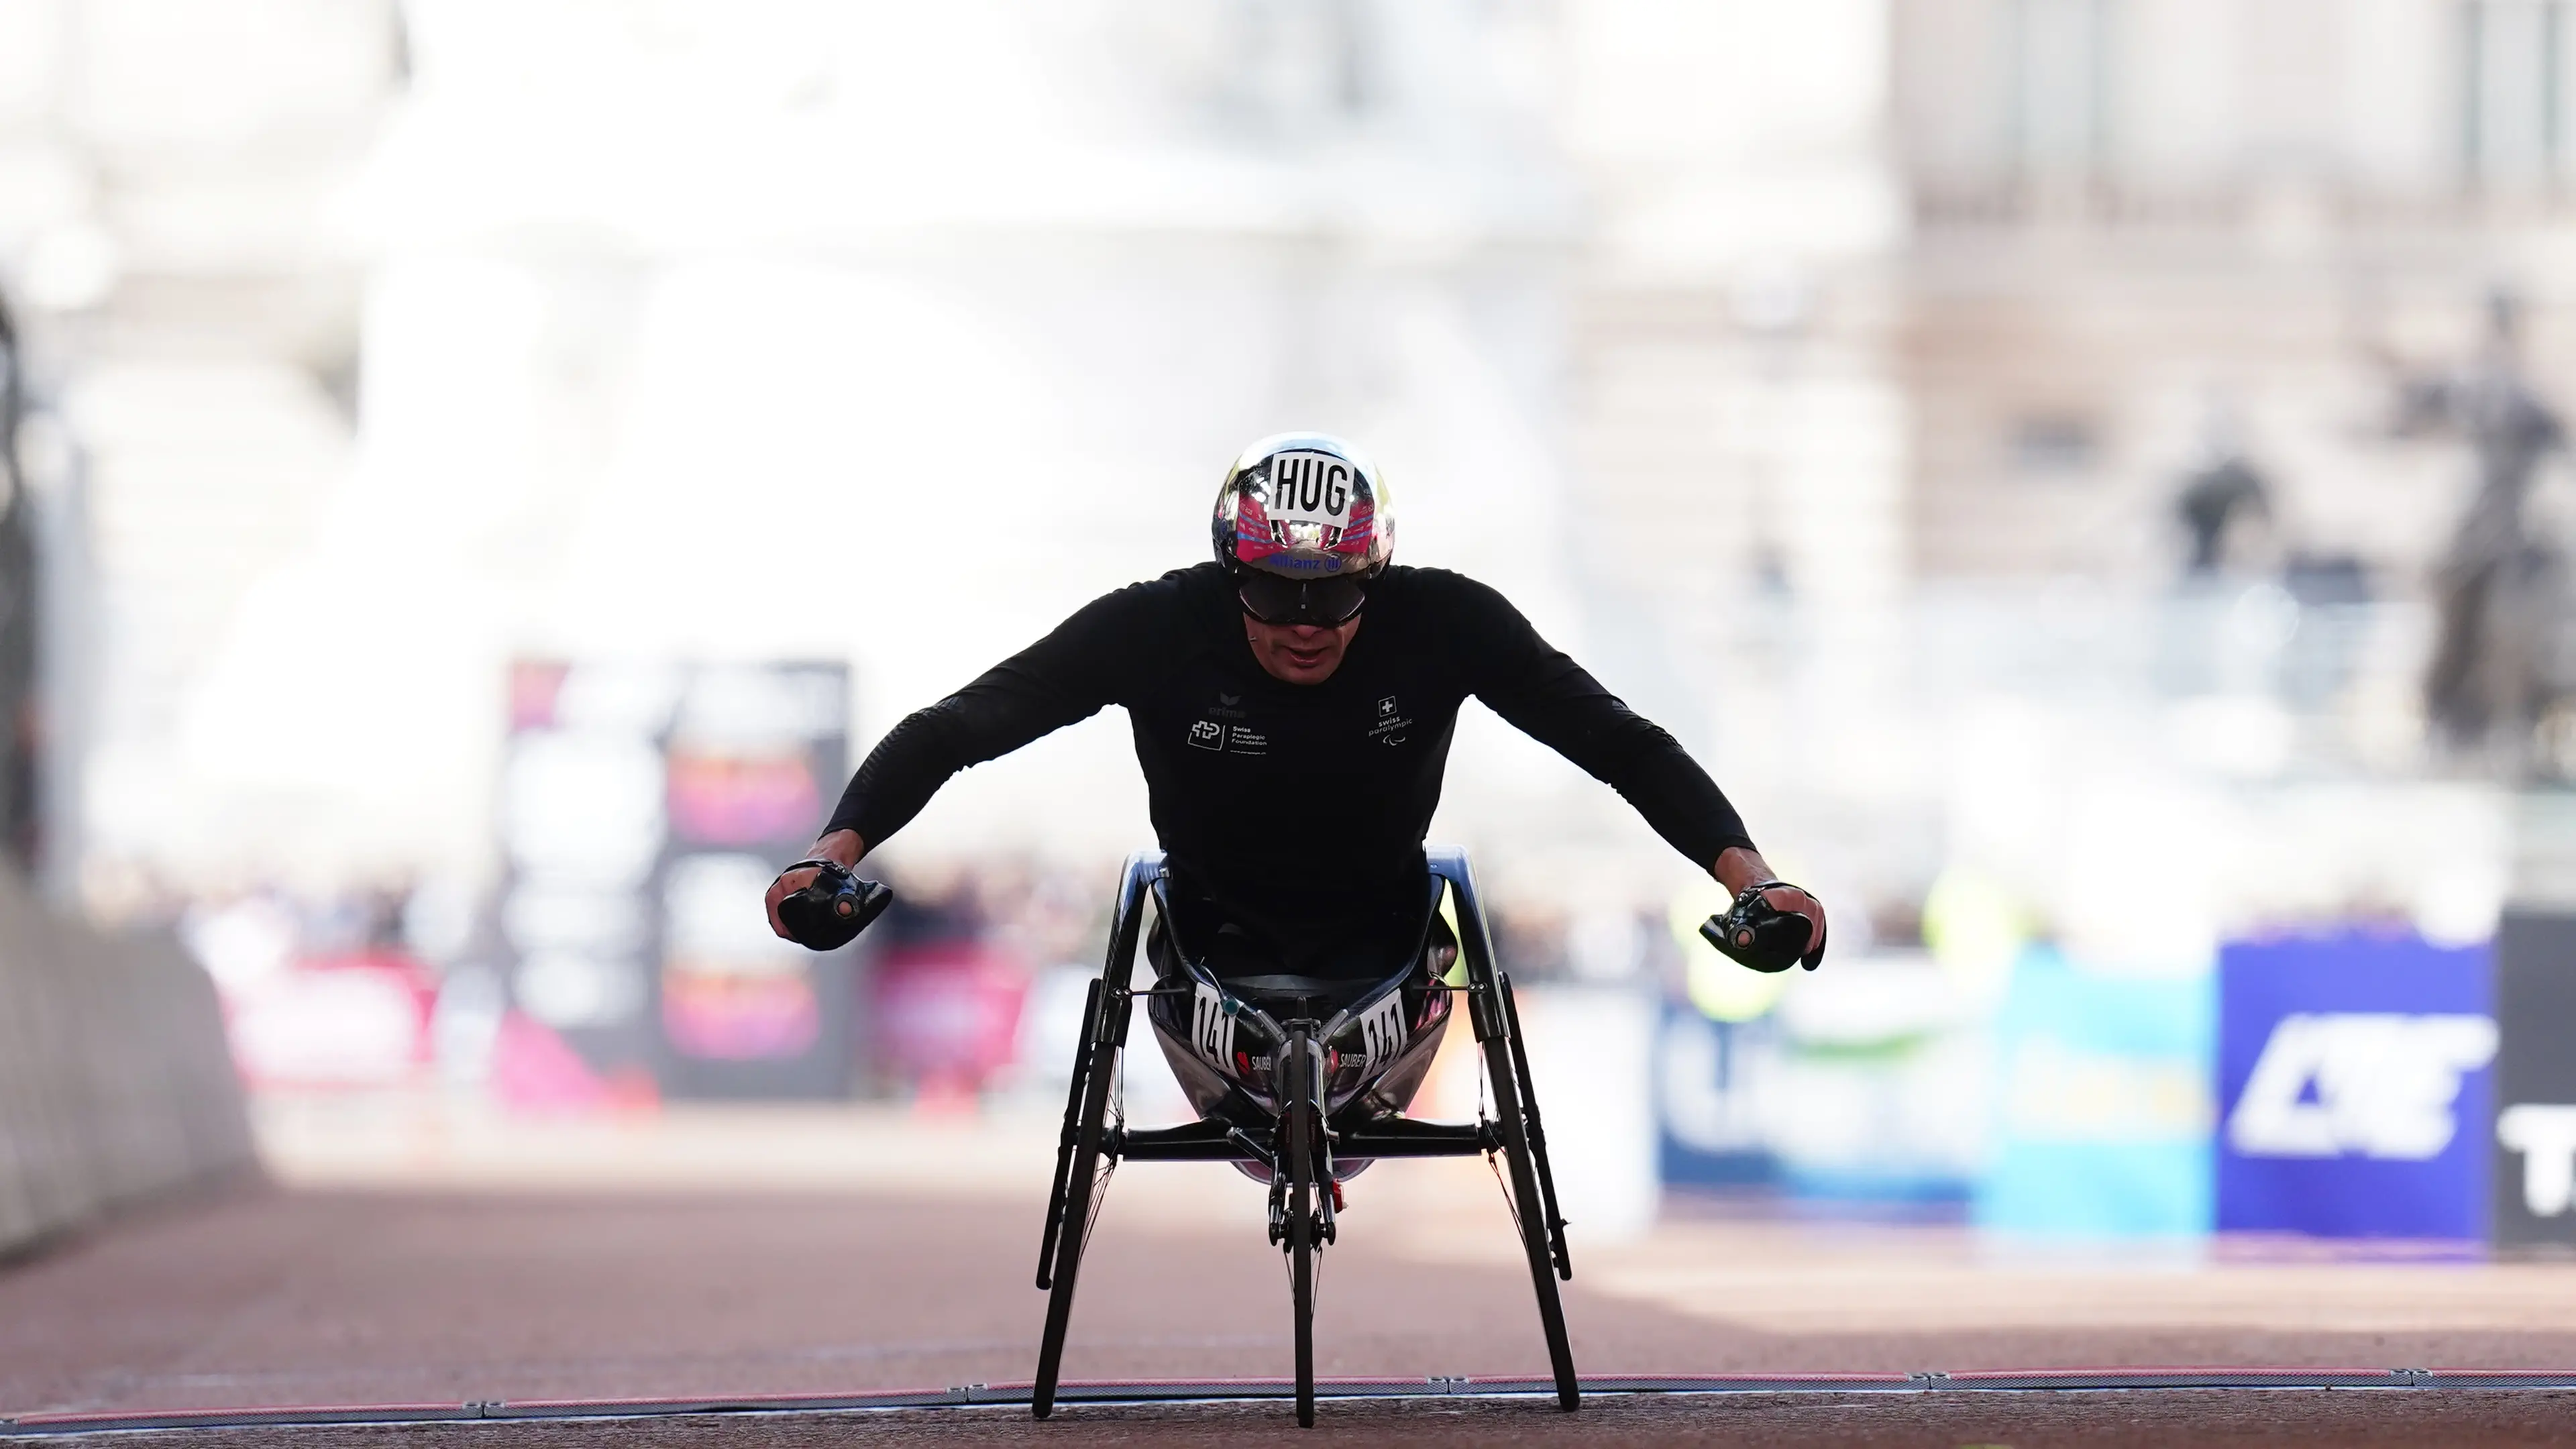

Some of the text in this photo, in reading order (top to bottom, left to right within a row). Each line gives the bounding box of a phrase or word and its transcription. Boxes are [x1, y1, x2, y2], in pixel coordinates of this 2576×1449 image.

[1274, 458, 1348, 517] HUG
[1269, 553, 1320, 570] Allianz
[1368, 718, 1413, 737] paralympic
[1378, 716, 1401, 728] swiss
[1231, 738, 1267, 746] Foundation
[1199, 996, 1230, 1069] 141
[1367, 1002, 1402, 1076] 141
[1340, 1053, 1366, 1068] SAUBER
